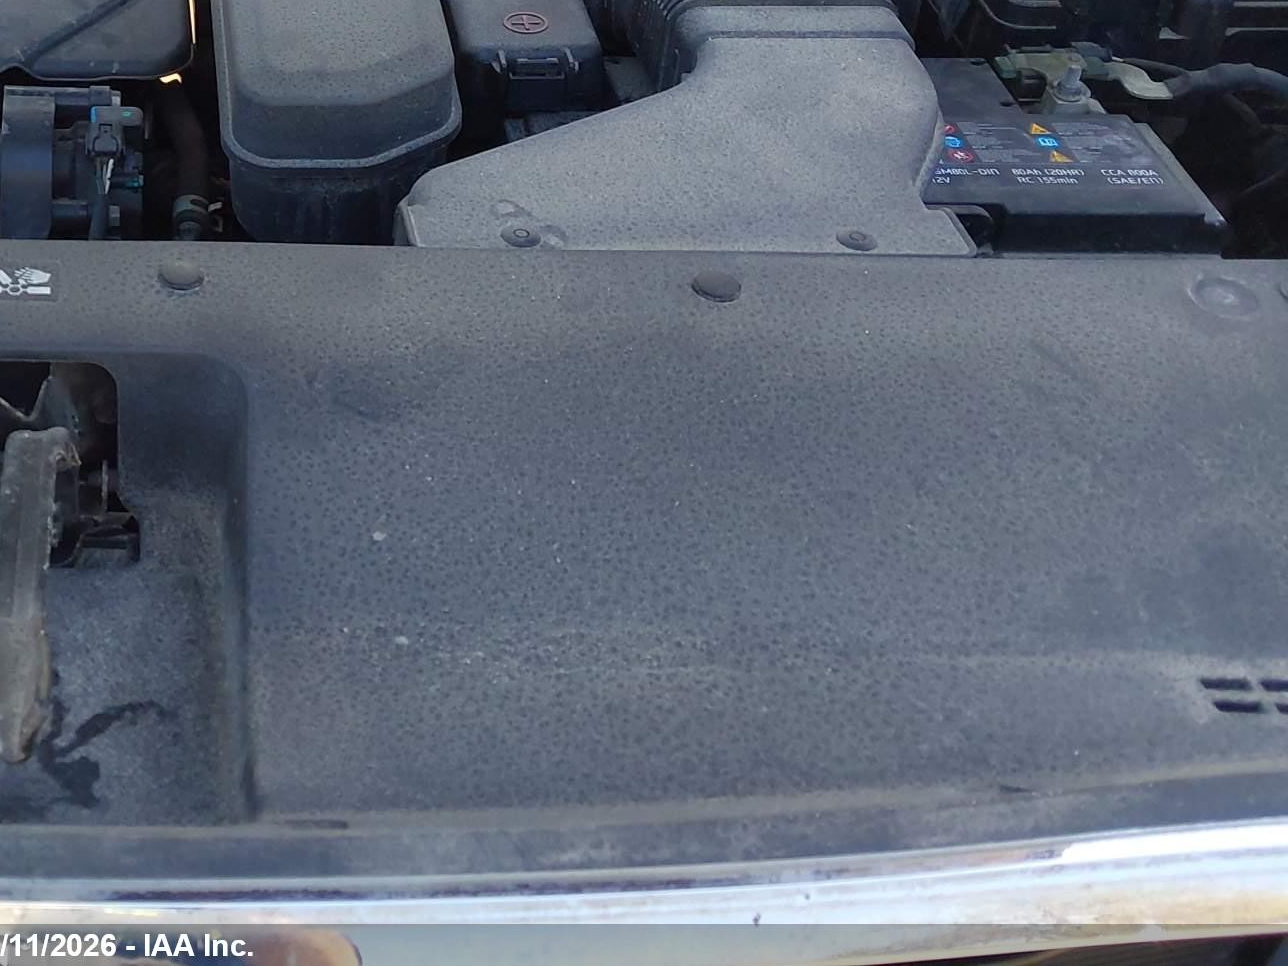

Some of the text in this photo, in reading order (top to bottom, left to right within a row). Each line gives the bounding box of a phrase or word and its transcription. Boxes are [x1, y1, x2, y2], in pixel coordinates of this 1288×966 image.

[1011, 168, 1085, 176] 80Ah (20HR)
[1016, 176, 1035, 184] RC
